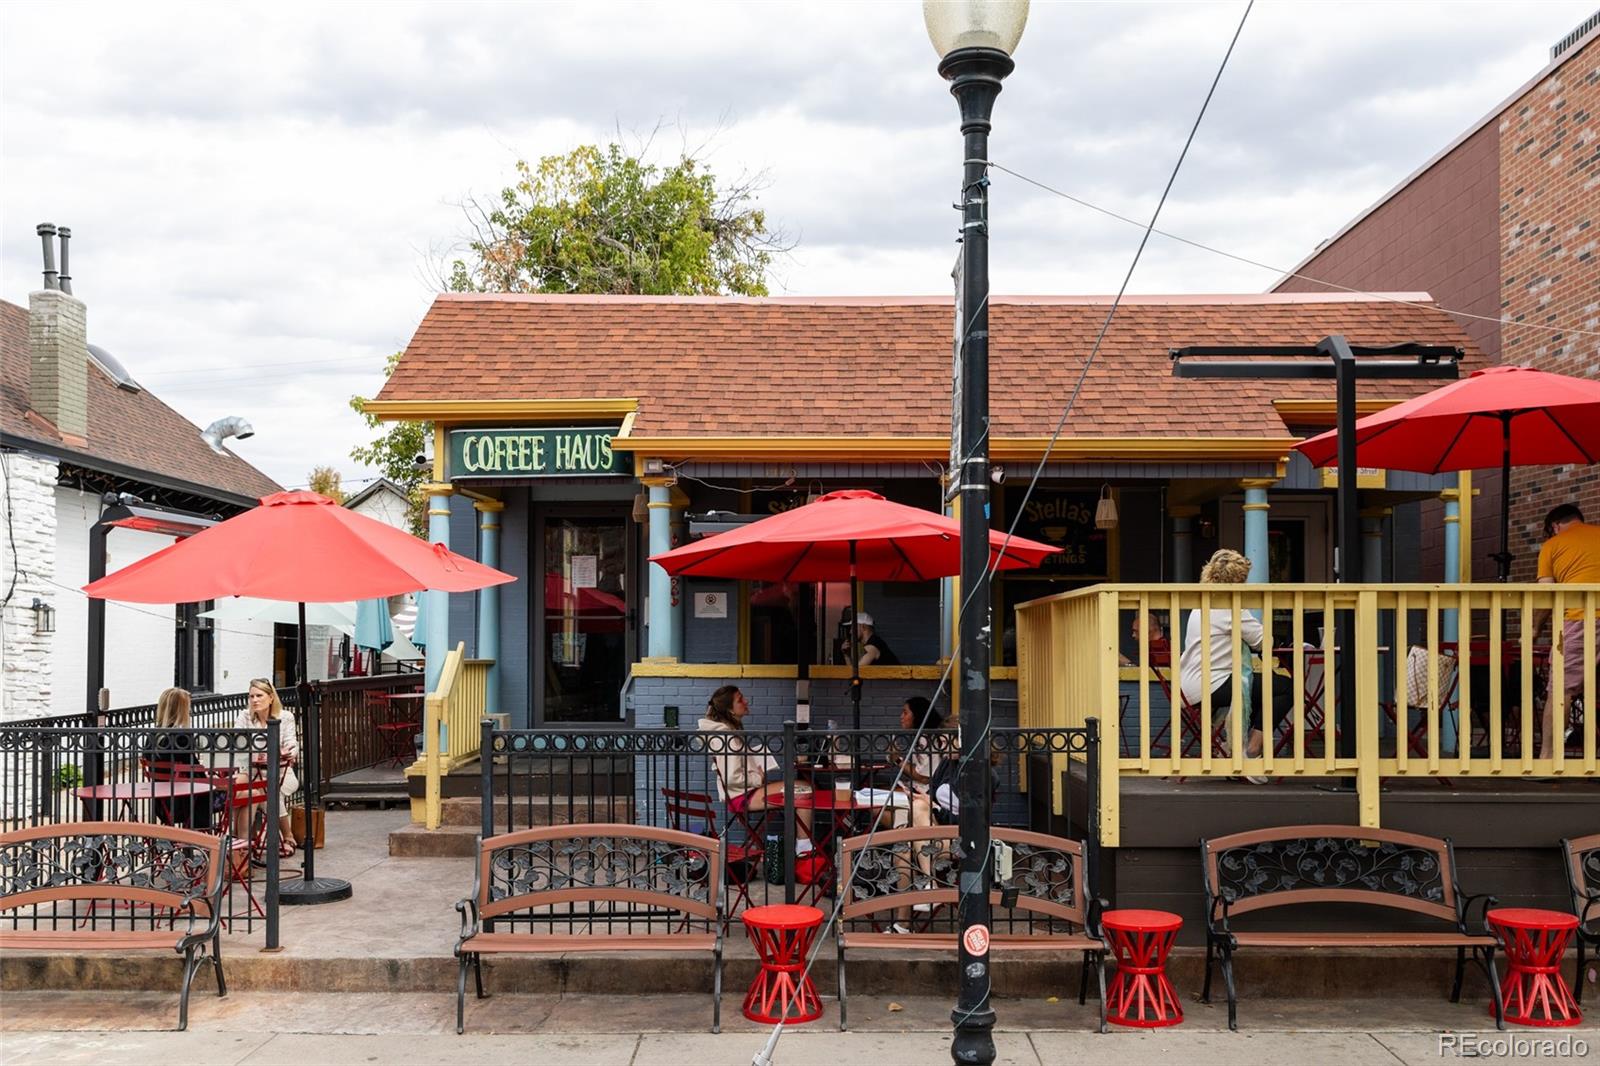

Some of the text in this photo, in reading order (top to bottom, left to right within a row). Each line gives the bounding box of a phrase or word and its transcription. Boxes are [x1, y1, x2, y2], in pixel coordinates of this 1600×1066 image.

[463, 434, 614, 472] COFFEE HAUS
[1025, 497, 1091, 524] Stella's
